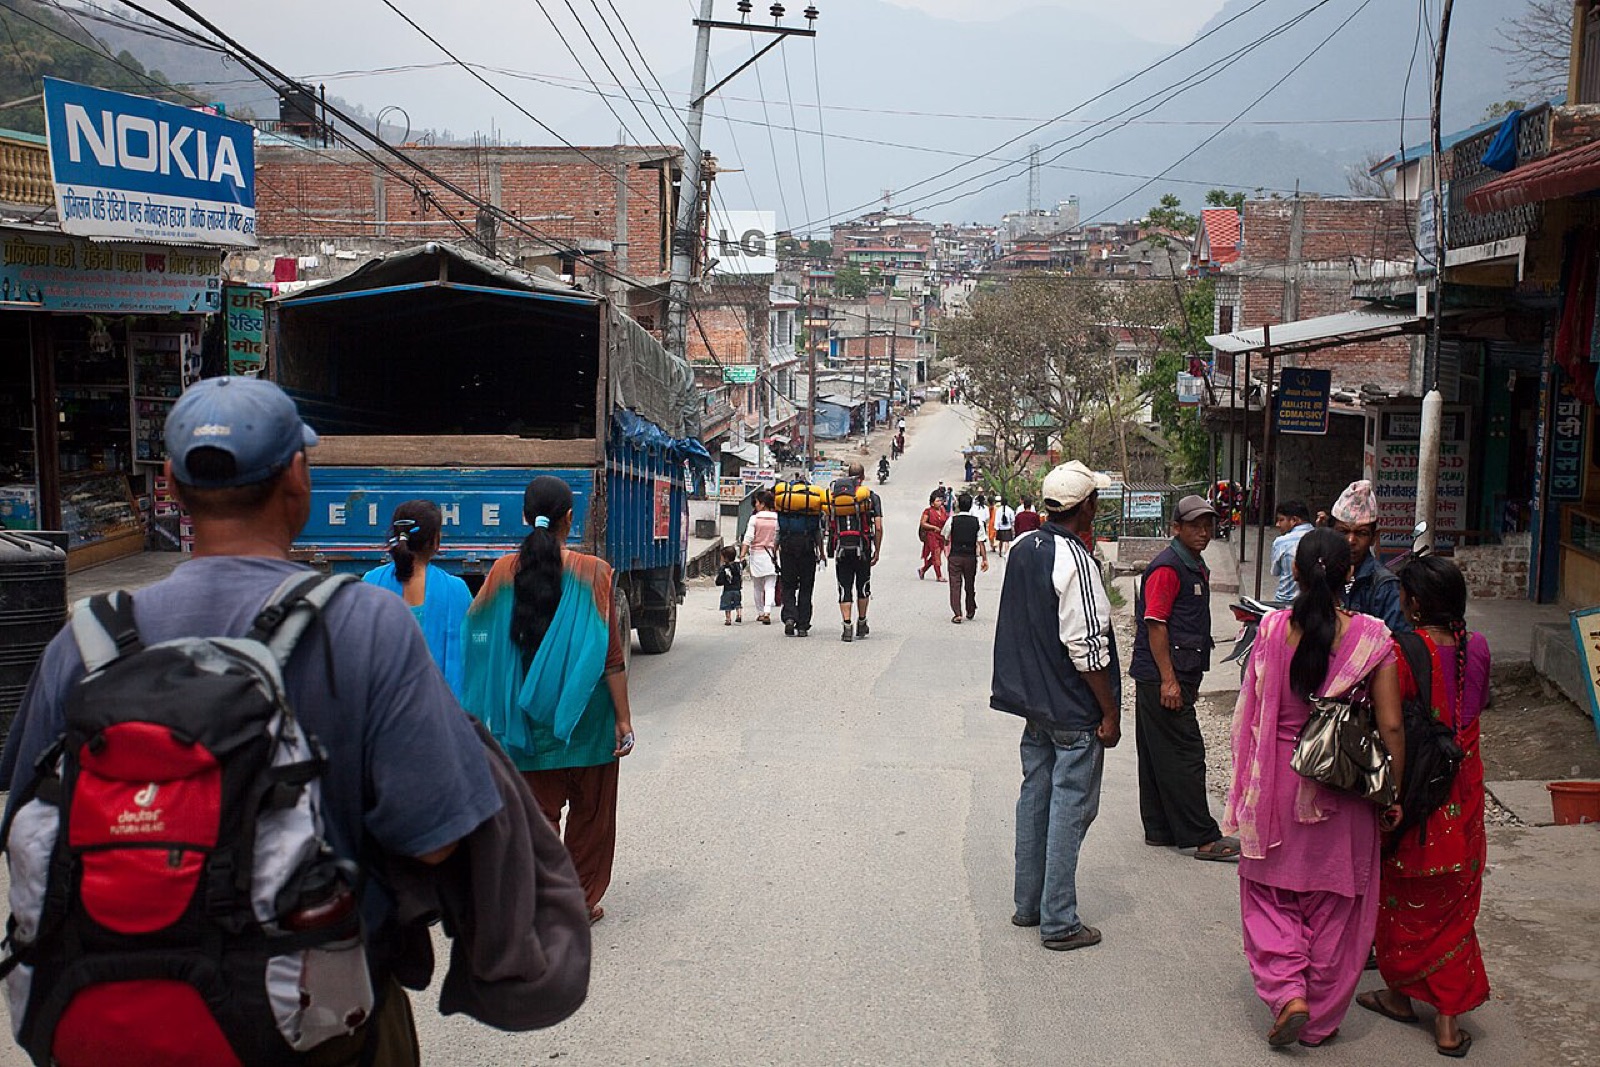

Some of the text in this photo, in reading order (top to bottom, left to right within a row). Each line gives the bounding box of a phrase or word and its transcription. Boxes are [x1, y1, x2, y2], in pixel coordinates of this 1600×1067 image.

[64, 103, 246, 188] NOKIA
[719, 229, 767, 257] LG
[118, 808, 164, 823] deuter
